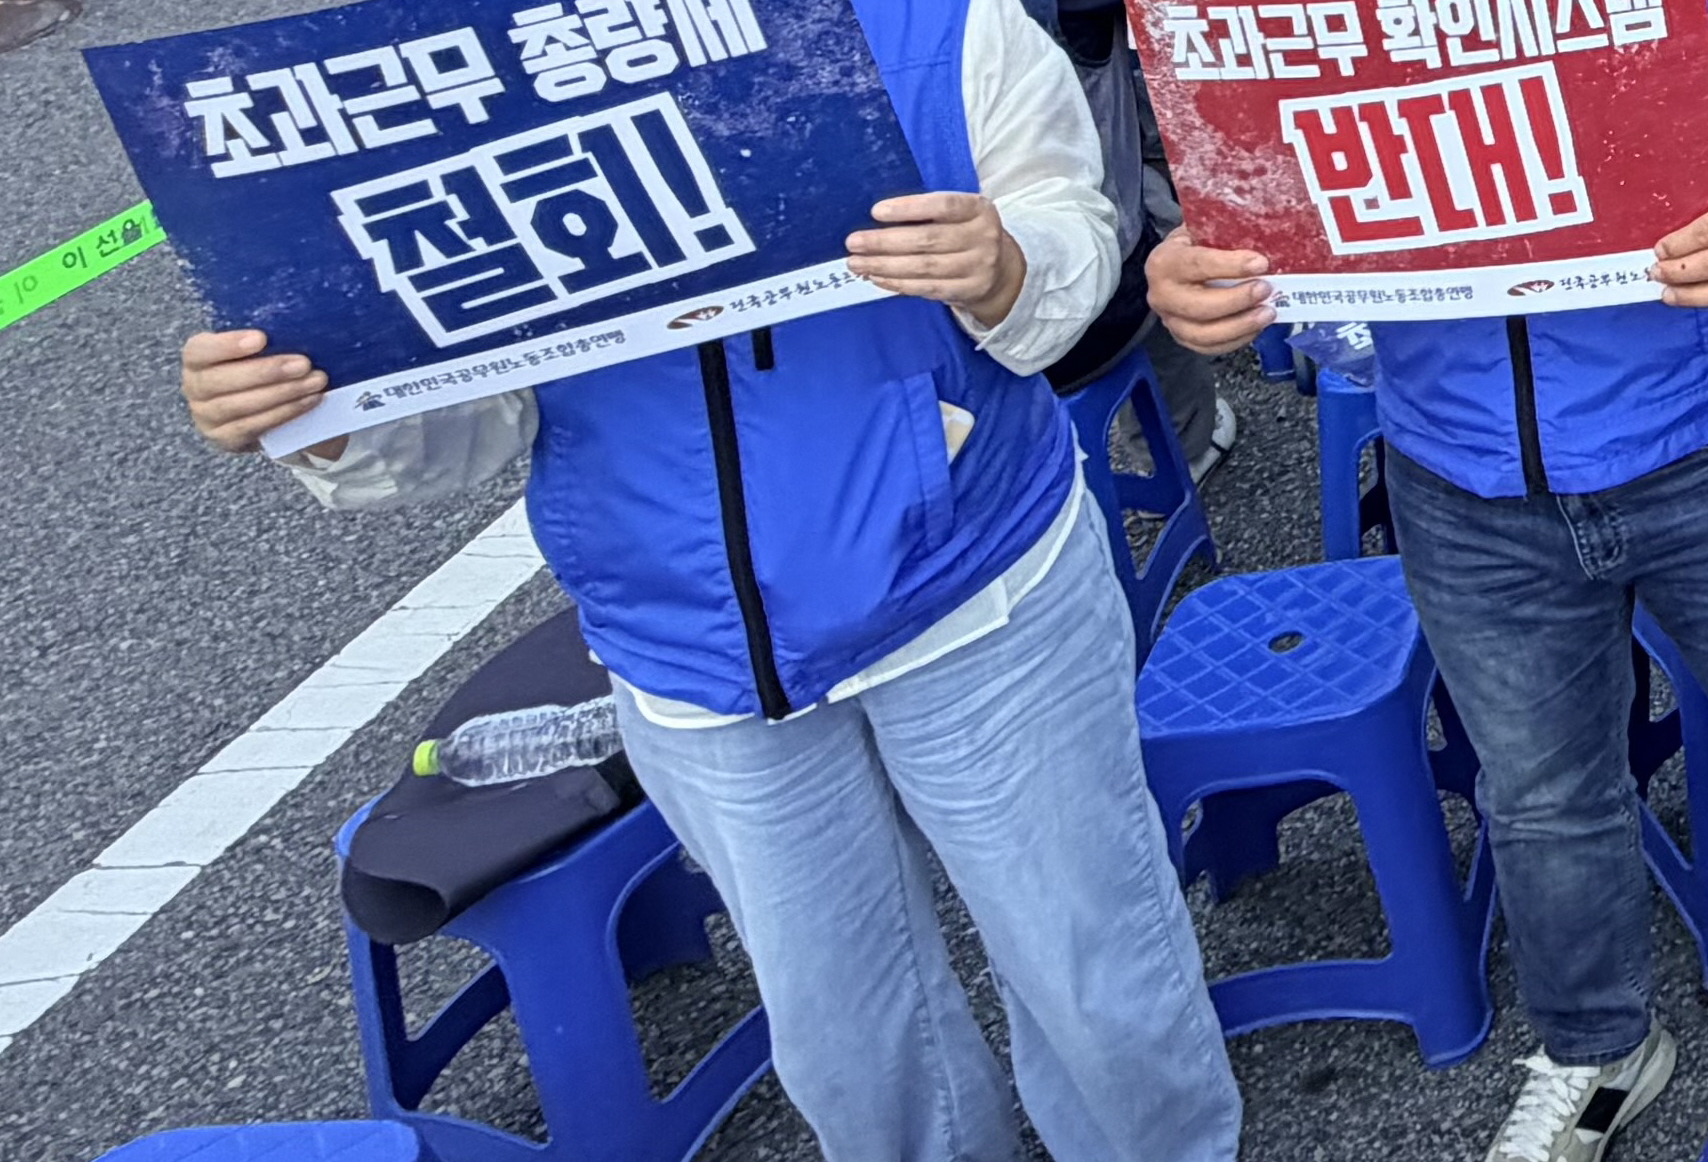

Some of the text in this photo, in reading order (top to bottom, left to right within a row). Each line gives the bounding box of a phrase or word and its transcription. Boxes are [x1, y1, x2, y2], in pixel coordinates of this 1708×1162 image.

[184, 27, 506, 181] 초과근무
[1163, 0, 1368, 81] 초과근무
[331, 89, 756, 349] 철회!
[1278, 60, 1595, 256] 반대!
